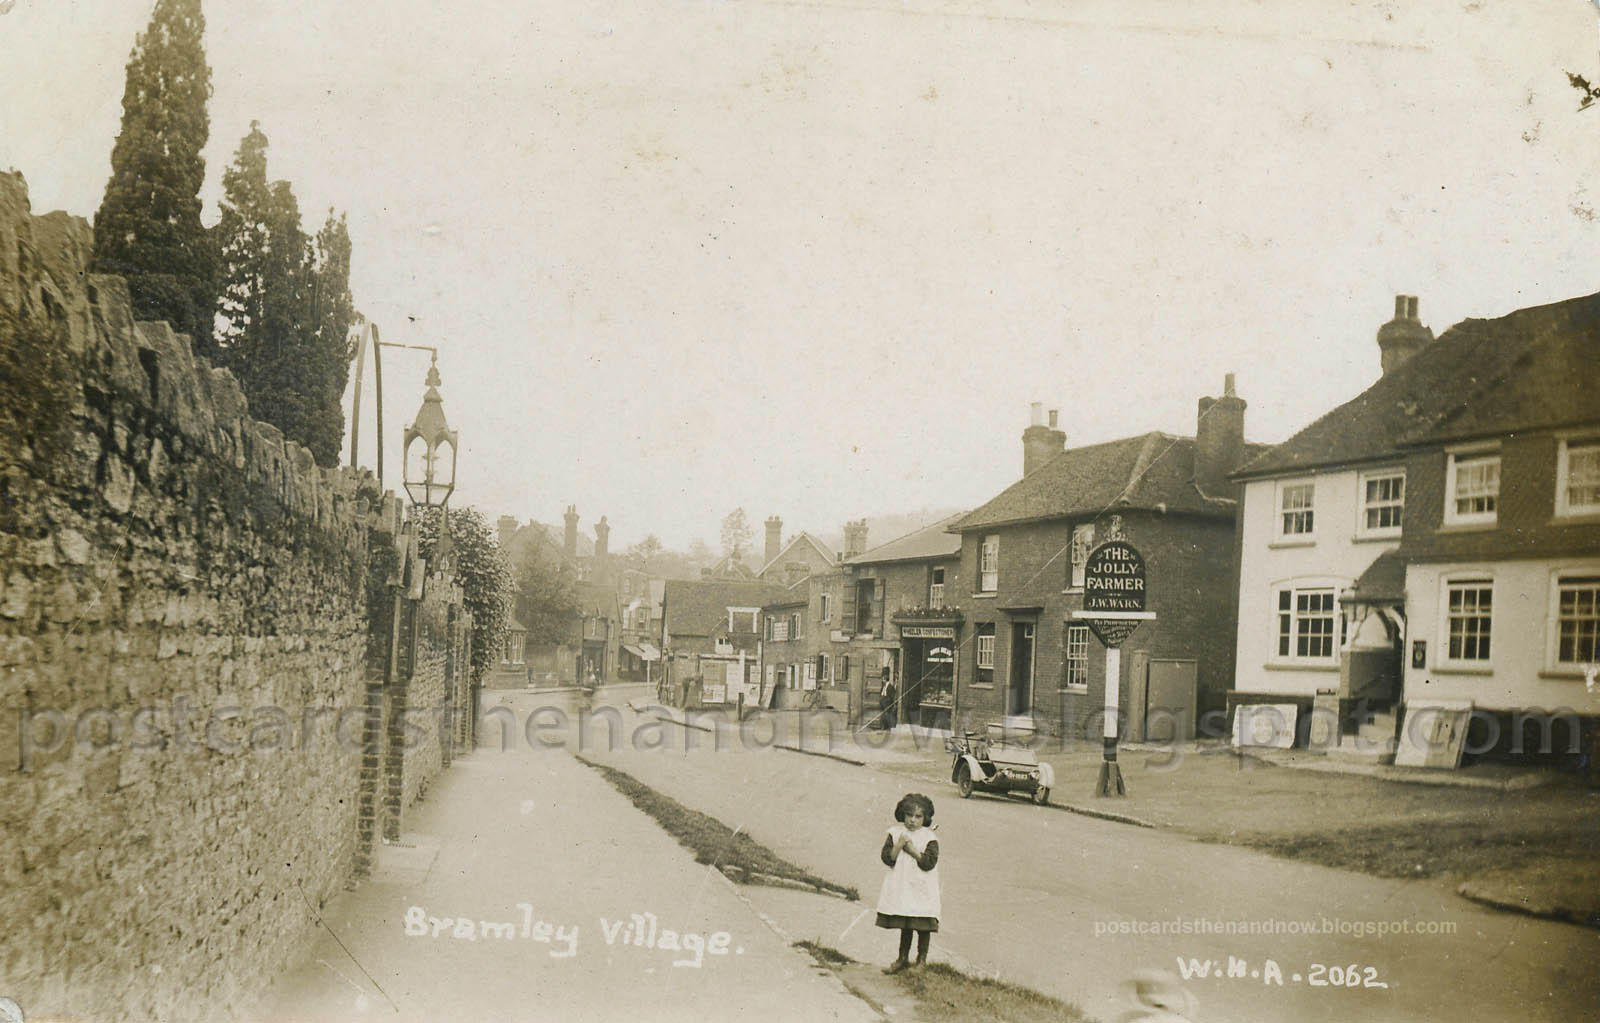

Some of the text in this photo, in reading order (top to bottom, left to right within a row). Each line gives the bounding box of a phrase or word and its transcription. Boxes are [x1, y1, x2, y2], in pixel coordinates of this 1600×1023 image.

[1103, 547, 1129, 560] THE
[1093, 563, 1138, 574] JOLLY
[1087, 577, 1143, 590] FARMER
